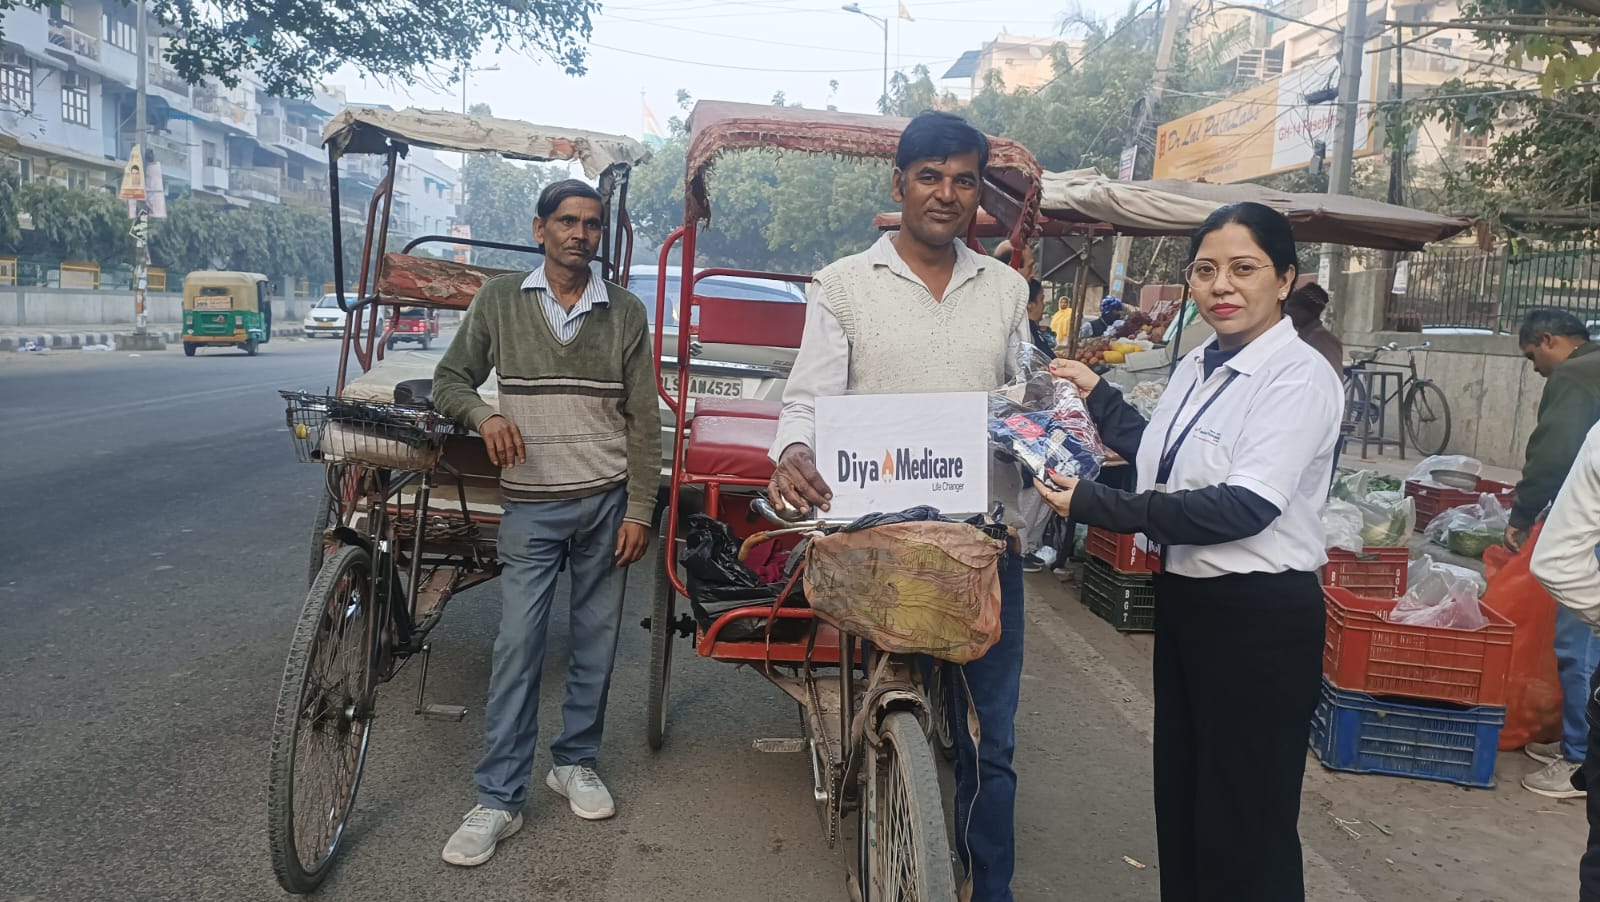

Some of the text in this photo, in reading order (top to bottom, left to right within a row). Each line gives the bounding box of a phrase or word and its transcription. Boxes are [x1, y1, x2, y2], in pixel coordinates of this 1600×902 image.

[837, 447, 963, 489] Diya Medicare
[931, 481, 965, 493] Life Changer
